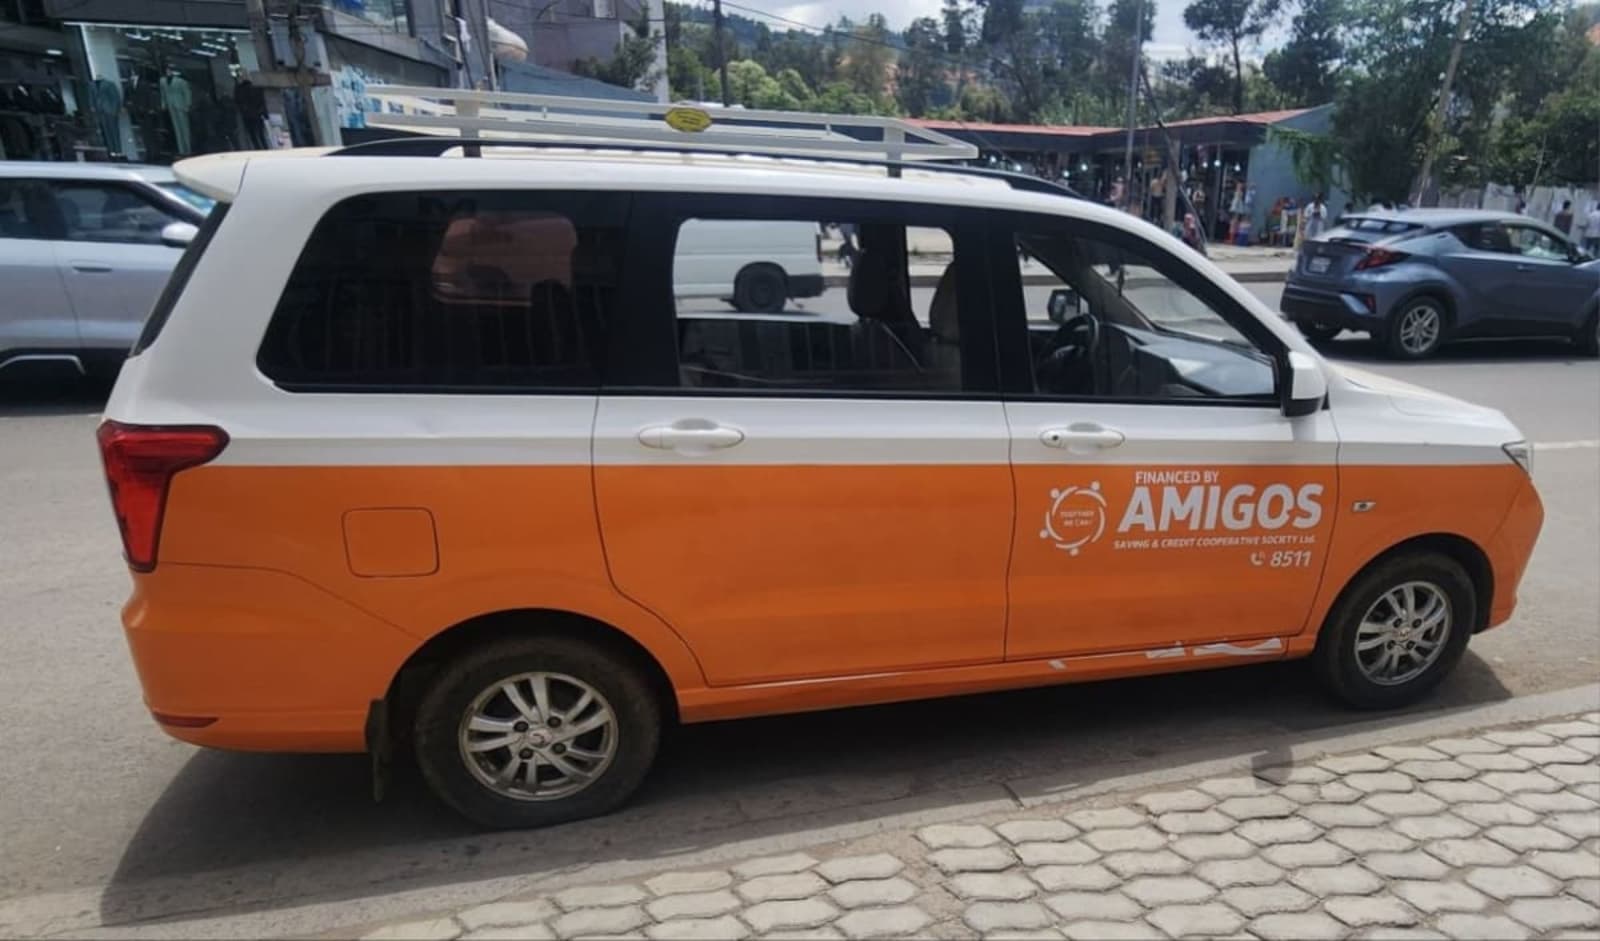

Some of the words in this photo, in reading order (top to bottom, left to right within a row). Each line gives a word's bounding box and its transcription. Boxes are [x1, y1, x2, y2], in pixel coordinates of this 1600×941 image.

[1135, 470, 1200, 484] FINANCED
[1203, 470, 1220, 484] BY
[1117, 483, 1324, 533] AMIGOS
[1114, 539, 1150, 549] SAVING
[1151, 539, 1159, 549] &
[1161, 538, 1196, 549] CREDIT
[1196, 536, 1260, 547] COOPERATIVE
[1261, 534, 1299, 545] SOCIETY
[1269, 550, 1313, 568] 8511
